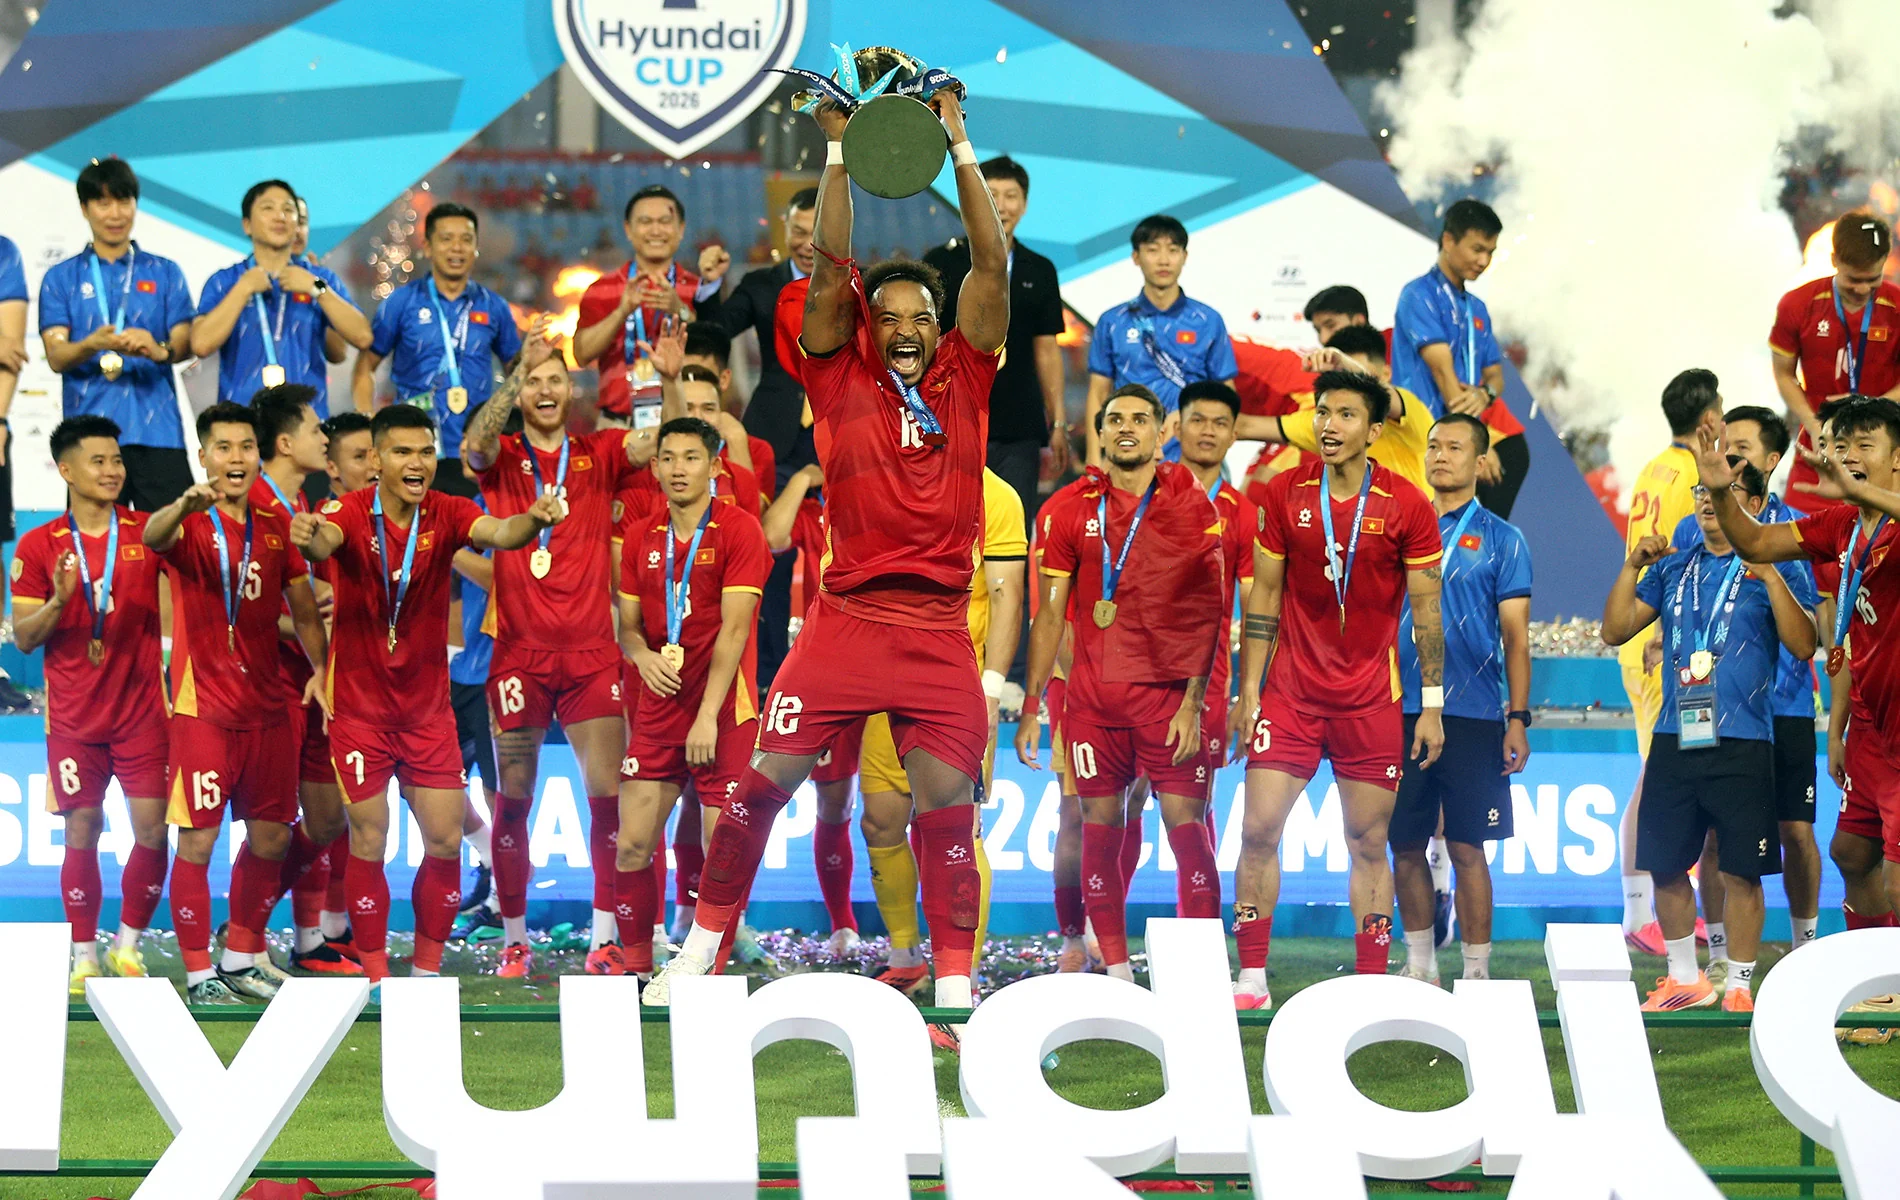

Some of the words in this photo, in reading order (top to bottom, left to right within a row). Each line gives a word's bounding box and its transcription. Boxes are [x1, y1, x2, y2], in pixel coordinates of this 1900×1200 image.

[599, 19, 761, 54] Hyundai
[636, 57, 724, 86] CUP
[659, 92, 700, 109] 2026
[497, 676, 526, 717] 13
[765, 690, 804, 736] 12
[1253, 718, 1273, 755] 5
[58, 756, 82, 796] 8
[345, 749, 366, 786] 7
[1072, 740, 1099, 780] 10
[191, 769, 222, 812] 15
